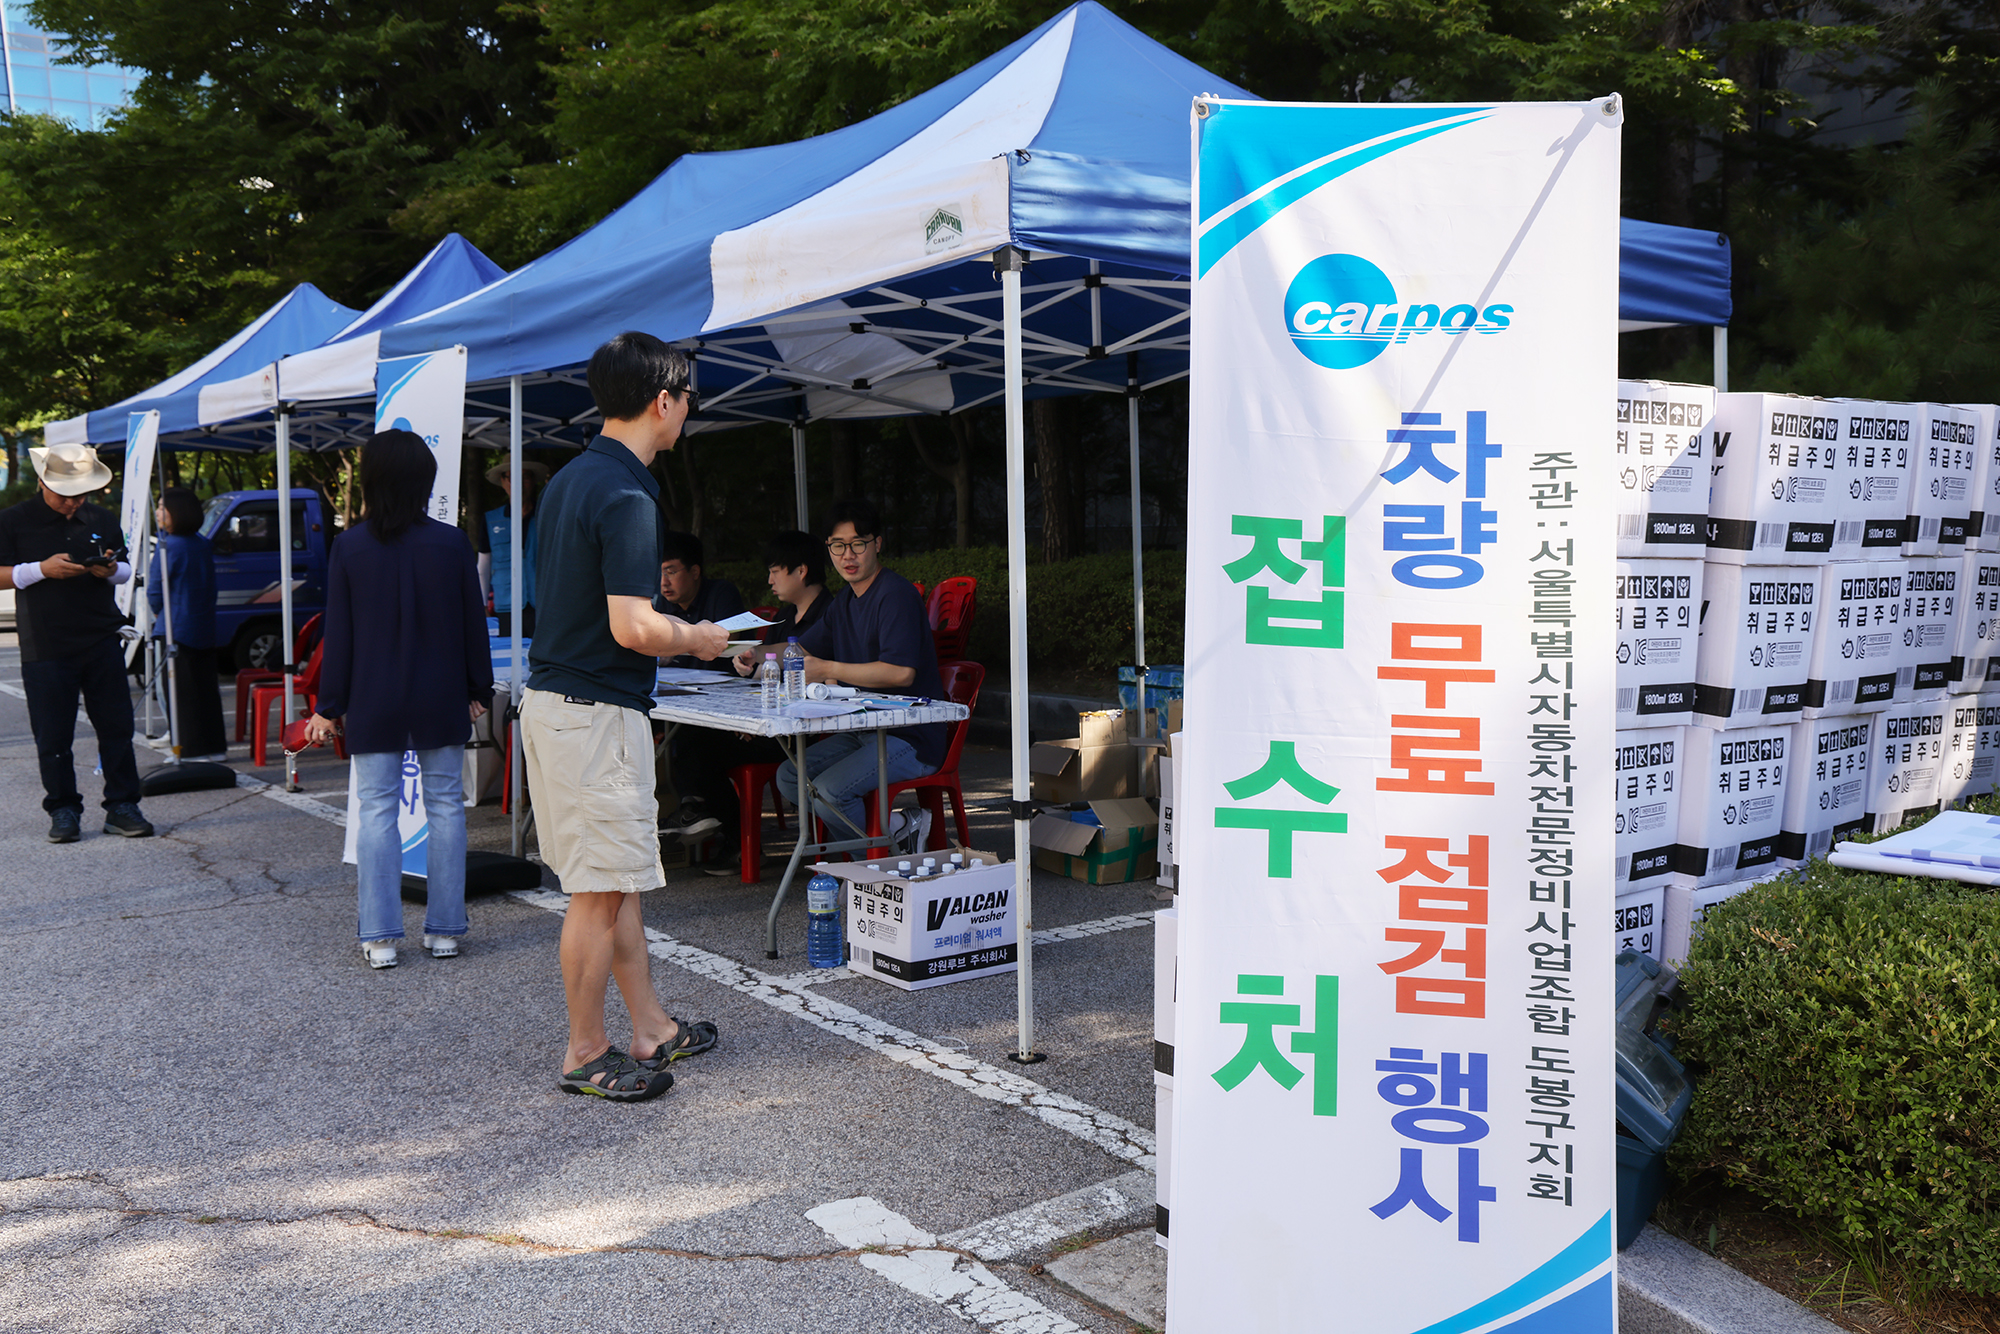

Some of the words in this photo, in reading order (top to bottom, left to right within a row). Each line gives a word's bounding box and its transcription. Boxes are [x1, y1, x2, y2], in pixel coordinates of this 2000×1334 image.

[933, 235, 955, 245] CANOPY
[1293, 301, 1515, 344] carpos
[1769, 443, 1836, 470] 취급주의
[1847, 445, 1907, 469] 취급주의
[1929, 446, 1973, 471] 취급주의
[1379, 411, 1503, 590] 차량
[1653, 523, 1677, 534] 1800ml
[1679, 523, 1695, 534] 12EA
[1747, 611, 1811, 634] 취급주의
[1838, 603, 1899, 628] 취급주의
[1375, 622, 1496, 796] 무료
[1645, 694, 1666, 706] 1800ml
[1668, 693, 1683, 704] 12EA
[1885, 740, 1941, 764] 취급주의
[1616, 770, 1674, 801] 급주의
[1719, 765, 1783, 793] 취급주의
[1211, 514, 1348, 1117] 접수처
[853, 895, 903, 924] 취급주의
[927, 889, 1009, 932] VALCAN
[970, 910, 1007, 925] washer
[934, 932, 972, 949] 프리미엄
[975, 926, 1002, 941] 워셔액
[1376, 834, 1489, 1019] 점검
[928, 957, 967, 974] 강원루브
[970, 948, 1008, 966] 주식회사
[1525, 1046, 1576, 1207] 도봉구지회
[1369, 1047, 1496, 1244] 행사
